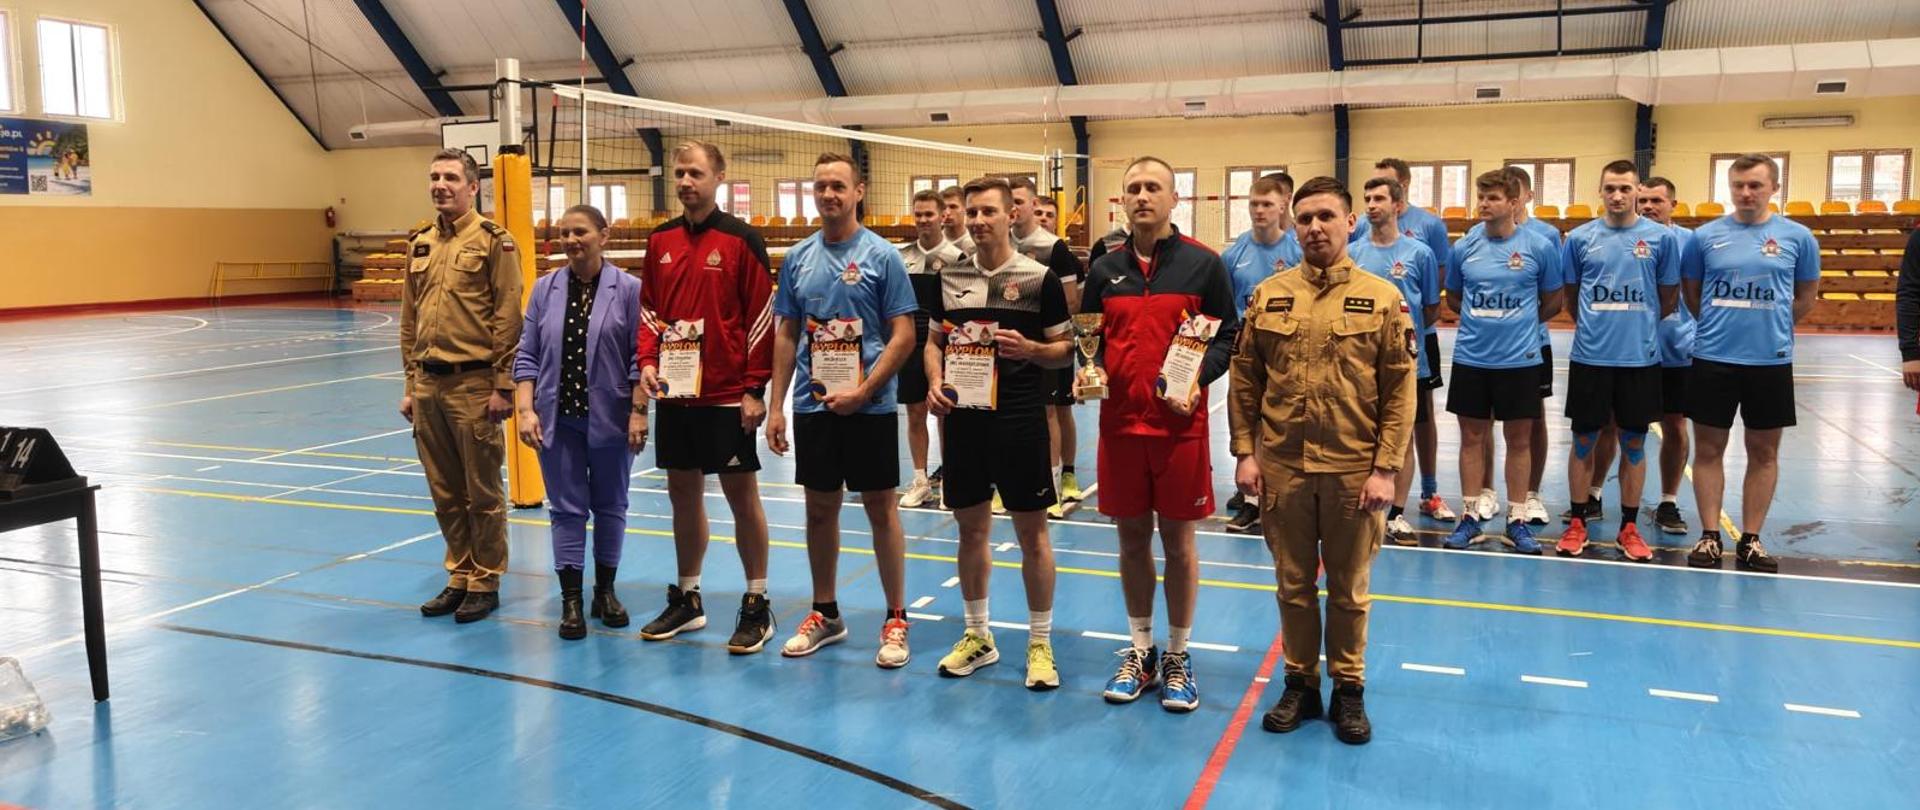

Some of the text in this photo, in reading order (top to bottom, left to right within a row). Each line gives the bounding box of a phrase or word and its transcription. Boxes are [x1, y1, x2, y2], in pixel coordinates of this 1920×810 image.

[1471, 292, 1522, 309] Delta
[1714, 280, 1775, 301] Delta
[11, 438, 36, 468] 14
